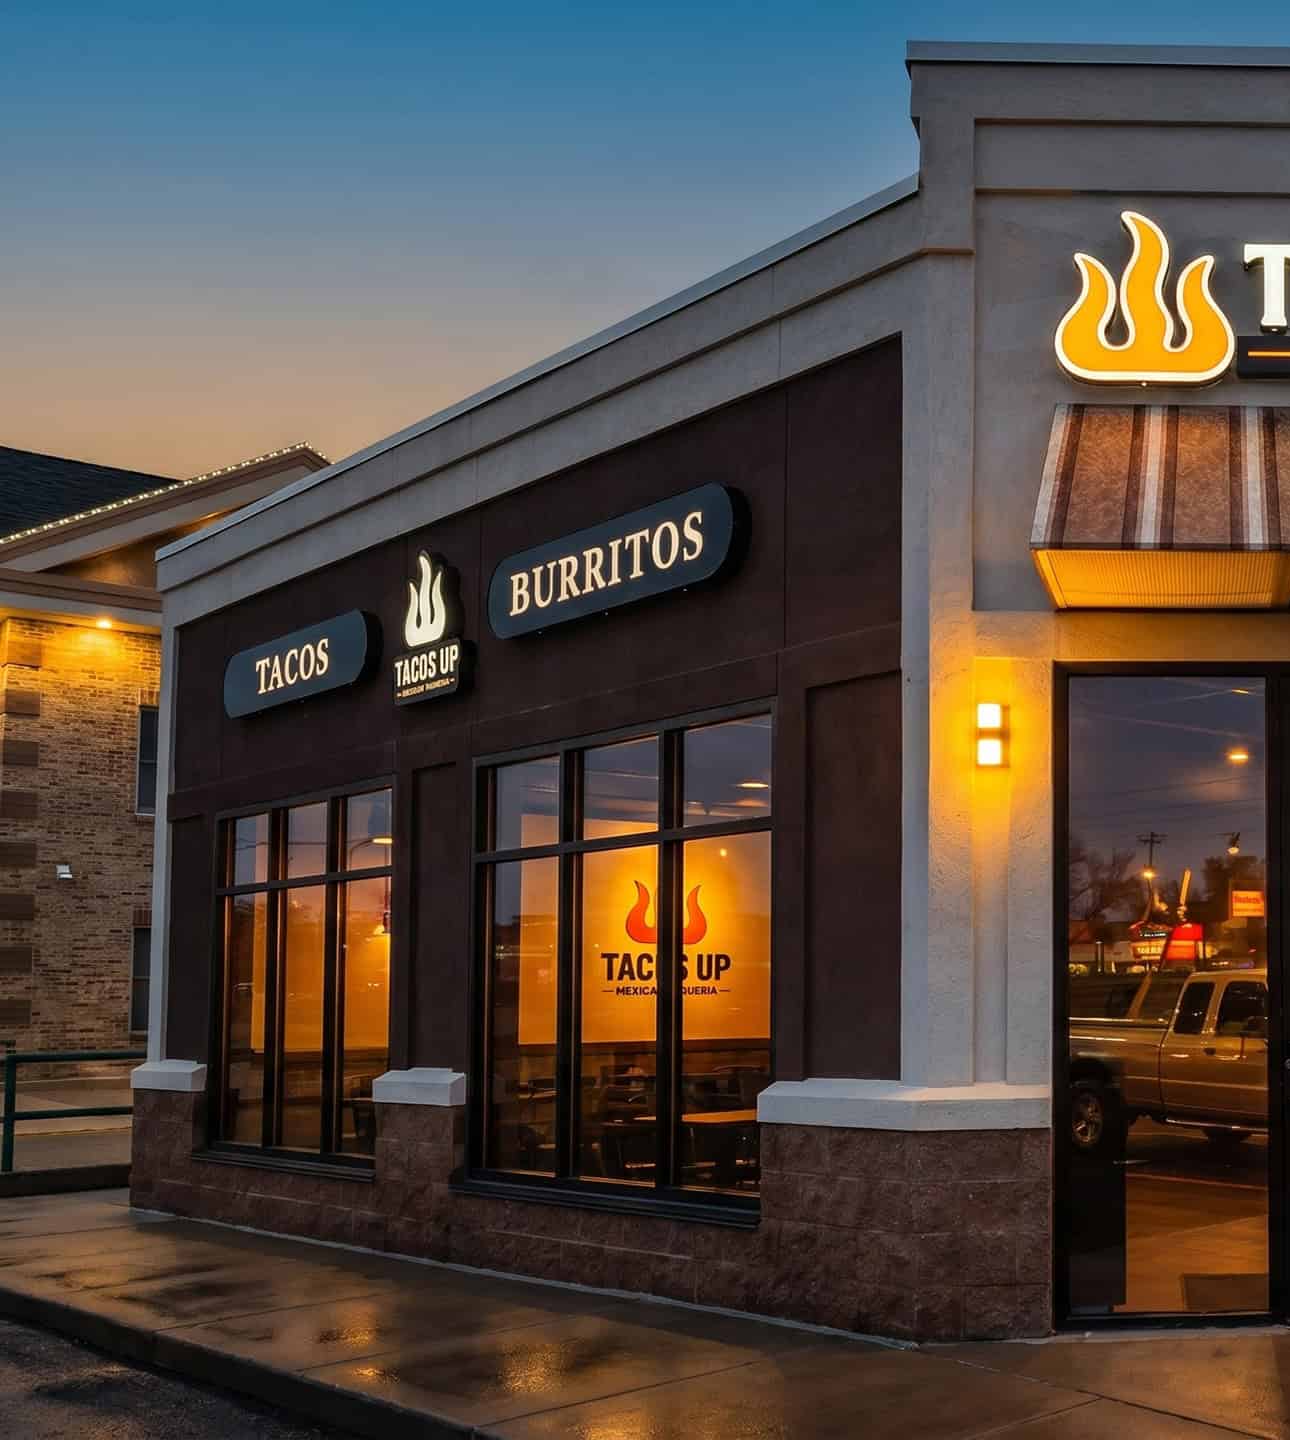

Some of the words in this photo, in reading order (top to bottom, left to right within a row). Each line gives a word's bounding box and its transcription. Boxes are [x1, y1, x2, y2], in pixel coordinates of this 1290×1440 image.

[509, 511, 704, 617] BURRITOS
[255, 638, 330, 696] TACOS
[394, 650, 437, 688] TACOS
[439, 645, 459, 675] UP
[600, 952, 688, 981] TAC
[696, 953, 731, 981] UP
[615, 985, 659, 996] MEXICA
